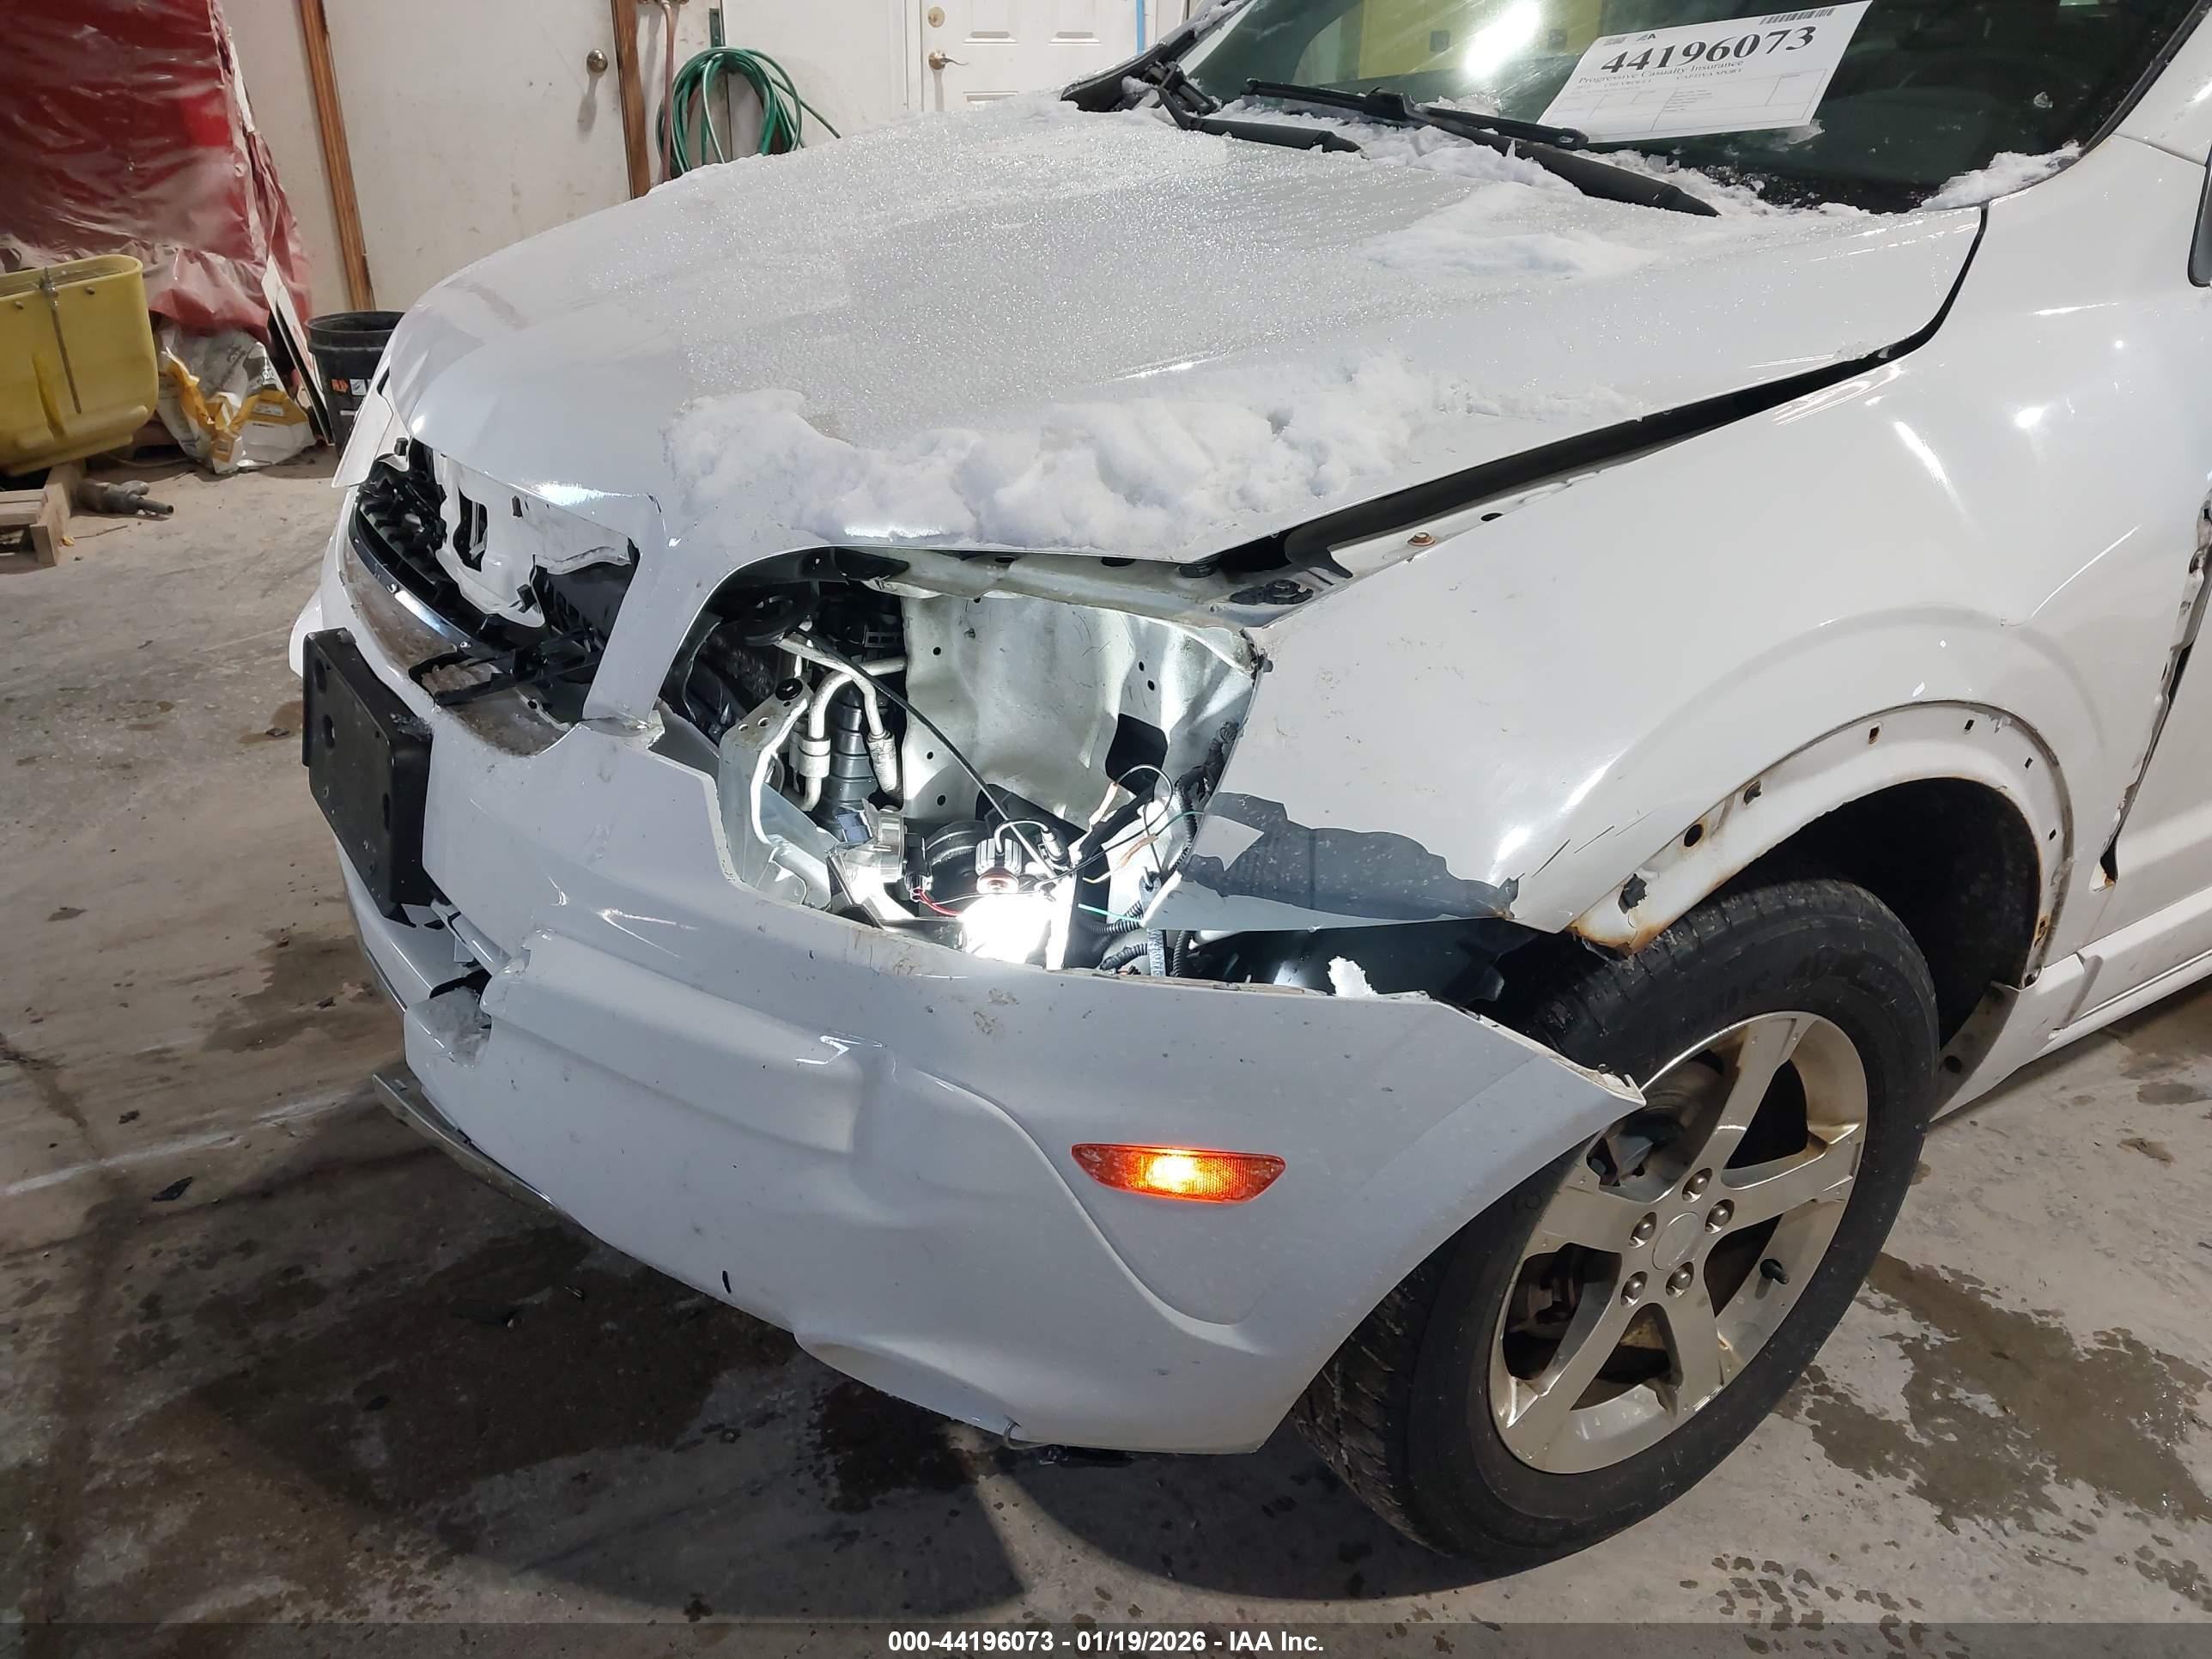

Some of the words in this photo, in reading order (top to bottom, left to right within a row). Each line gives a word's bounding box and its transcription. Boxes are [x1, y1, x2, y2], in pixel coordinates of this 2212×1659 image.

[1600, 26, 1817, 74] 44196073
[1578, 75, 1636, 84] Progressive
[1641, 68, 1685, 77] Casualty
[1690, 60, 1745, 72] Insurance
